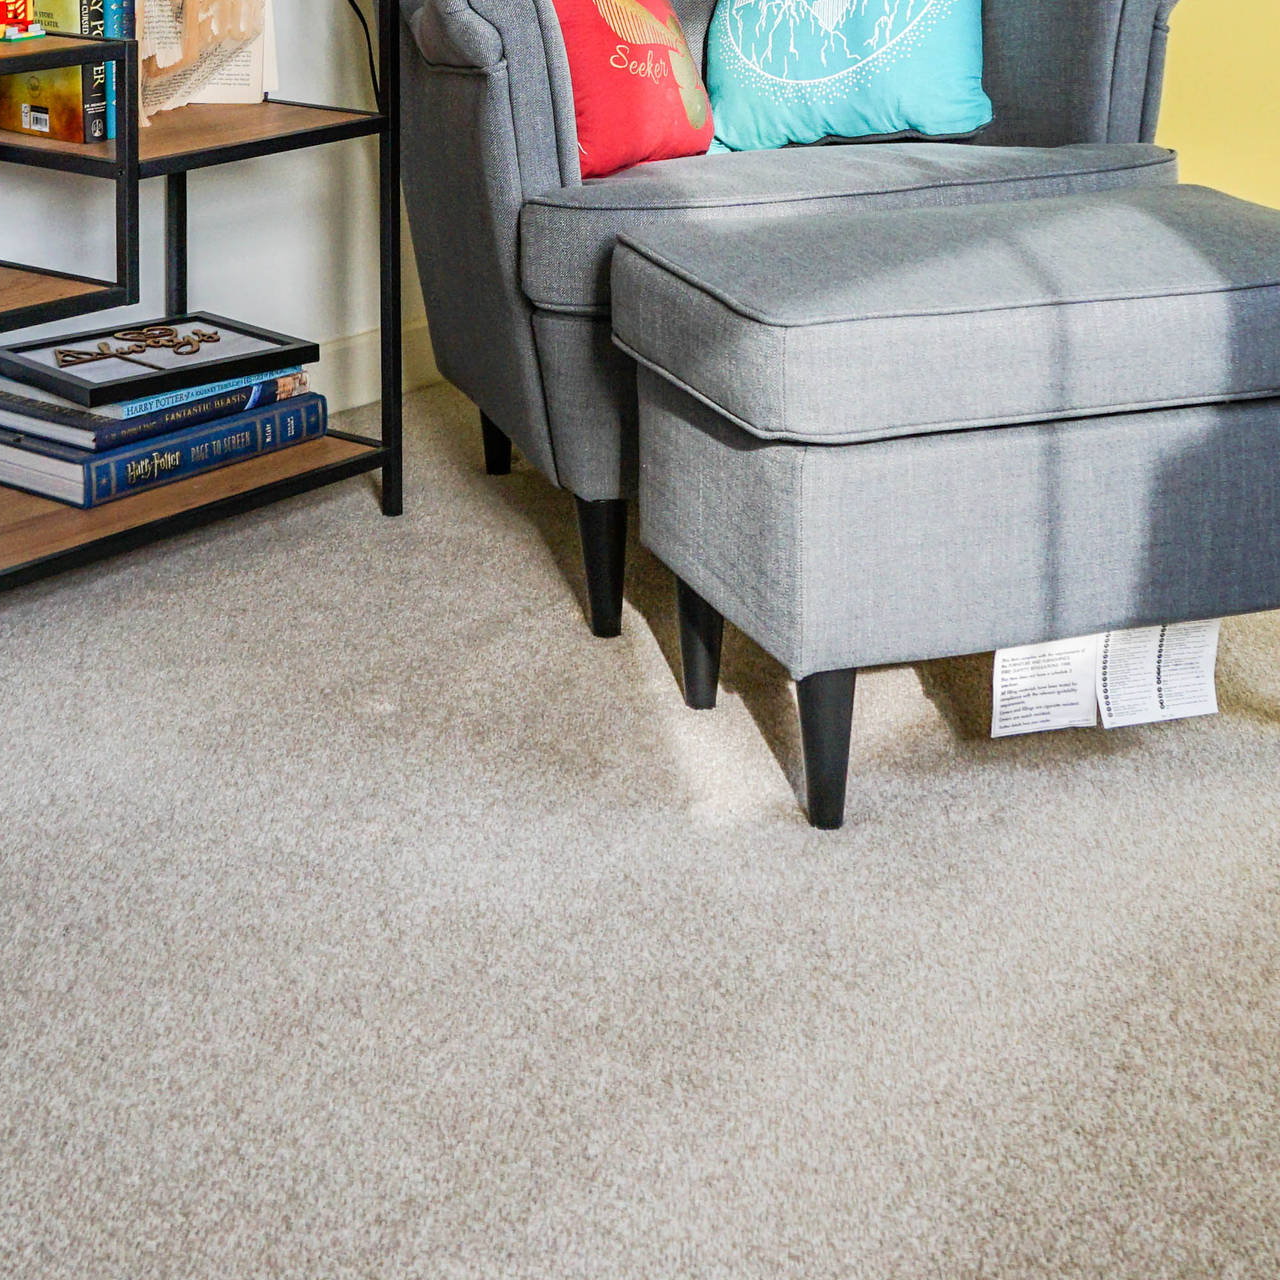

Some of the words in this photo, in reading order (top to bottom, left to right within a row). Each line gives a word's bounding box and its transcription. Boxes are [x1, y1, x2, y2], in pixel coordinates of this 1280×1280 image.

[81, 5, 89, 35] CURSED
[610, 45, 669, 84] Seeker
[127, 400, 154, 417] HARRY
[155, 393, 185, 410] POTTER
[165, 402, 211, 423] FANTASTIC
[214, 392, 247, 409] BEASTS
[126, 459, 151, 484] Harry
[151, 449, 181, 479] Potter
[190, 444, 209, 462] PAGE
[211, 440, 221, 457] TO
[223, 431, 252, 452] SCREEN
